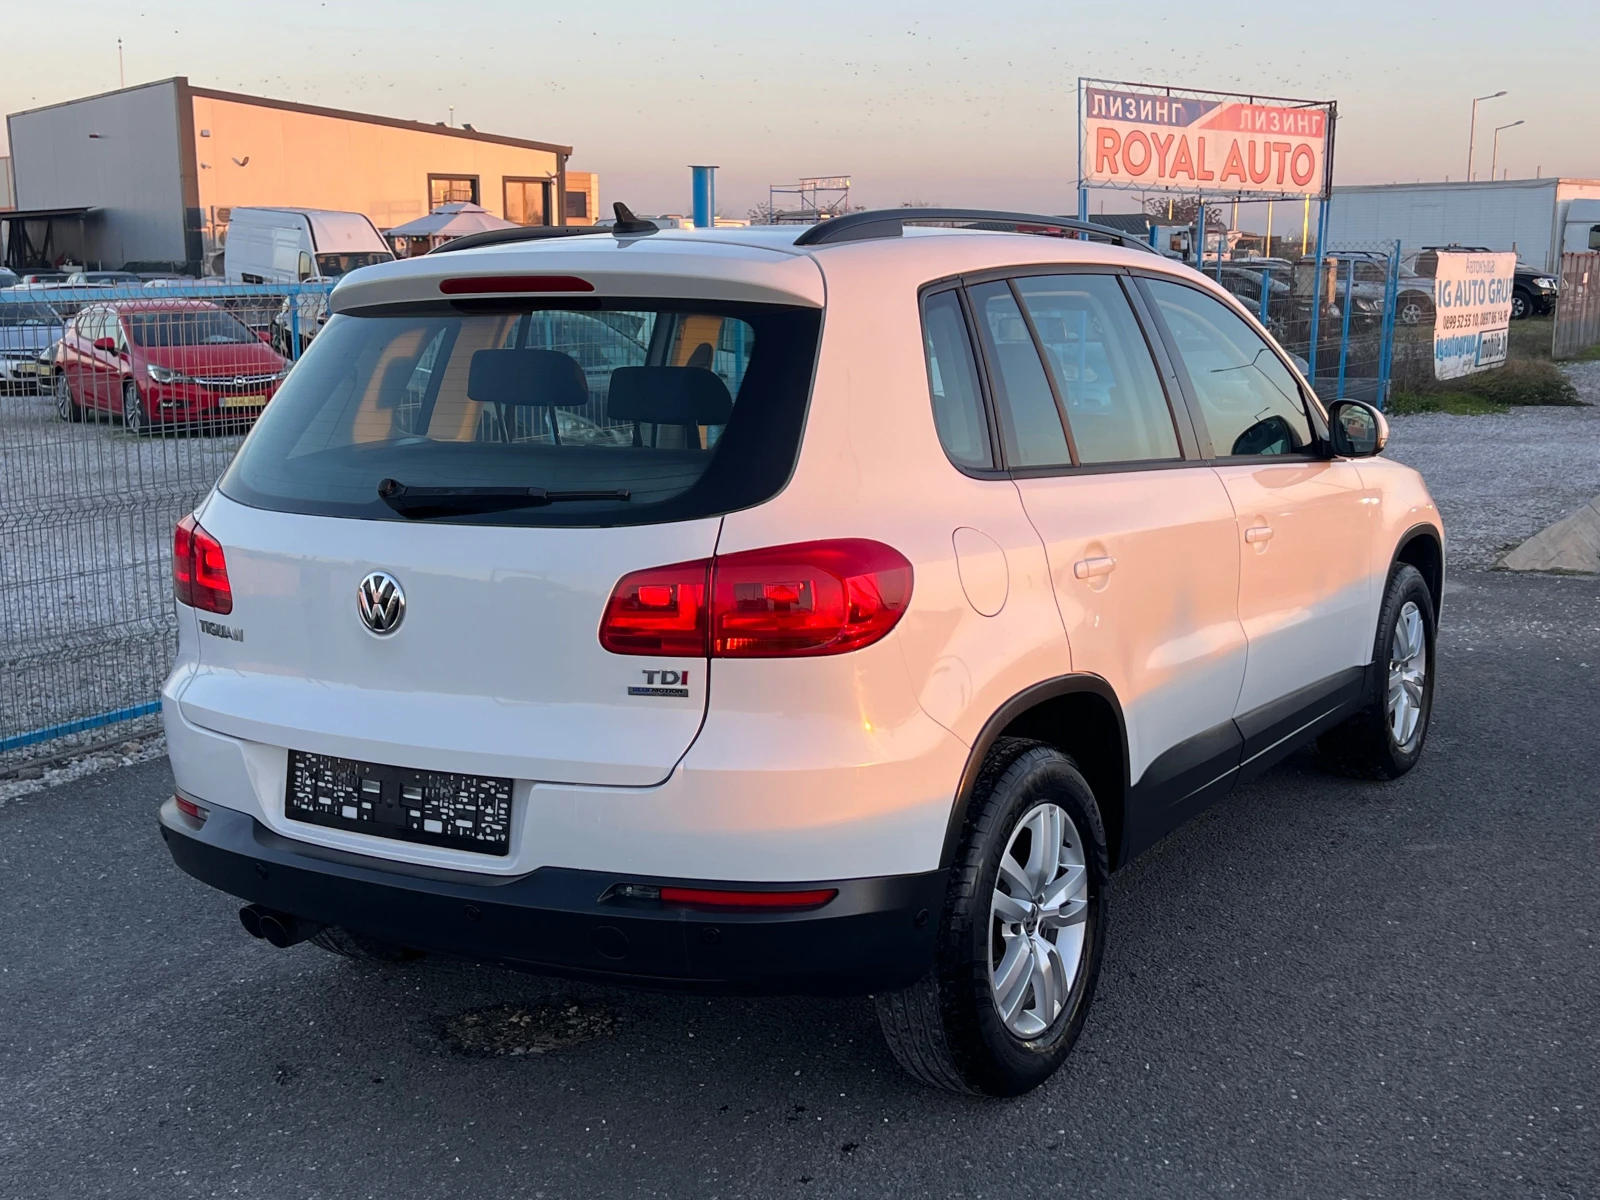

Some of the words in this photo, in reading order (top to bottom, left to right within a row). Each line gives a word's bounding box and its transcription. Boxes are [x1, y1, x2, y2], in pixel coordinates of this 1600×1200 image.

[1092, 94, 1182, 124] ЛИЗИНГ
[1240, 109, 1320, 134] ЛИЗИНГ
[1096, 127, 1214, 181] ROYAL
[1220, 139, 1315, 186] AUTO
[1438, 279, 1451, 308] IG
[1454, 279, 1486, 307] AUTO
[359, 572, 406, 633] VW
[199, 618, 244, 642] TIGUAN
[642, 669, 688, 685] TDI
